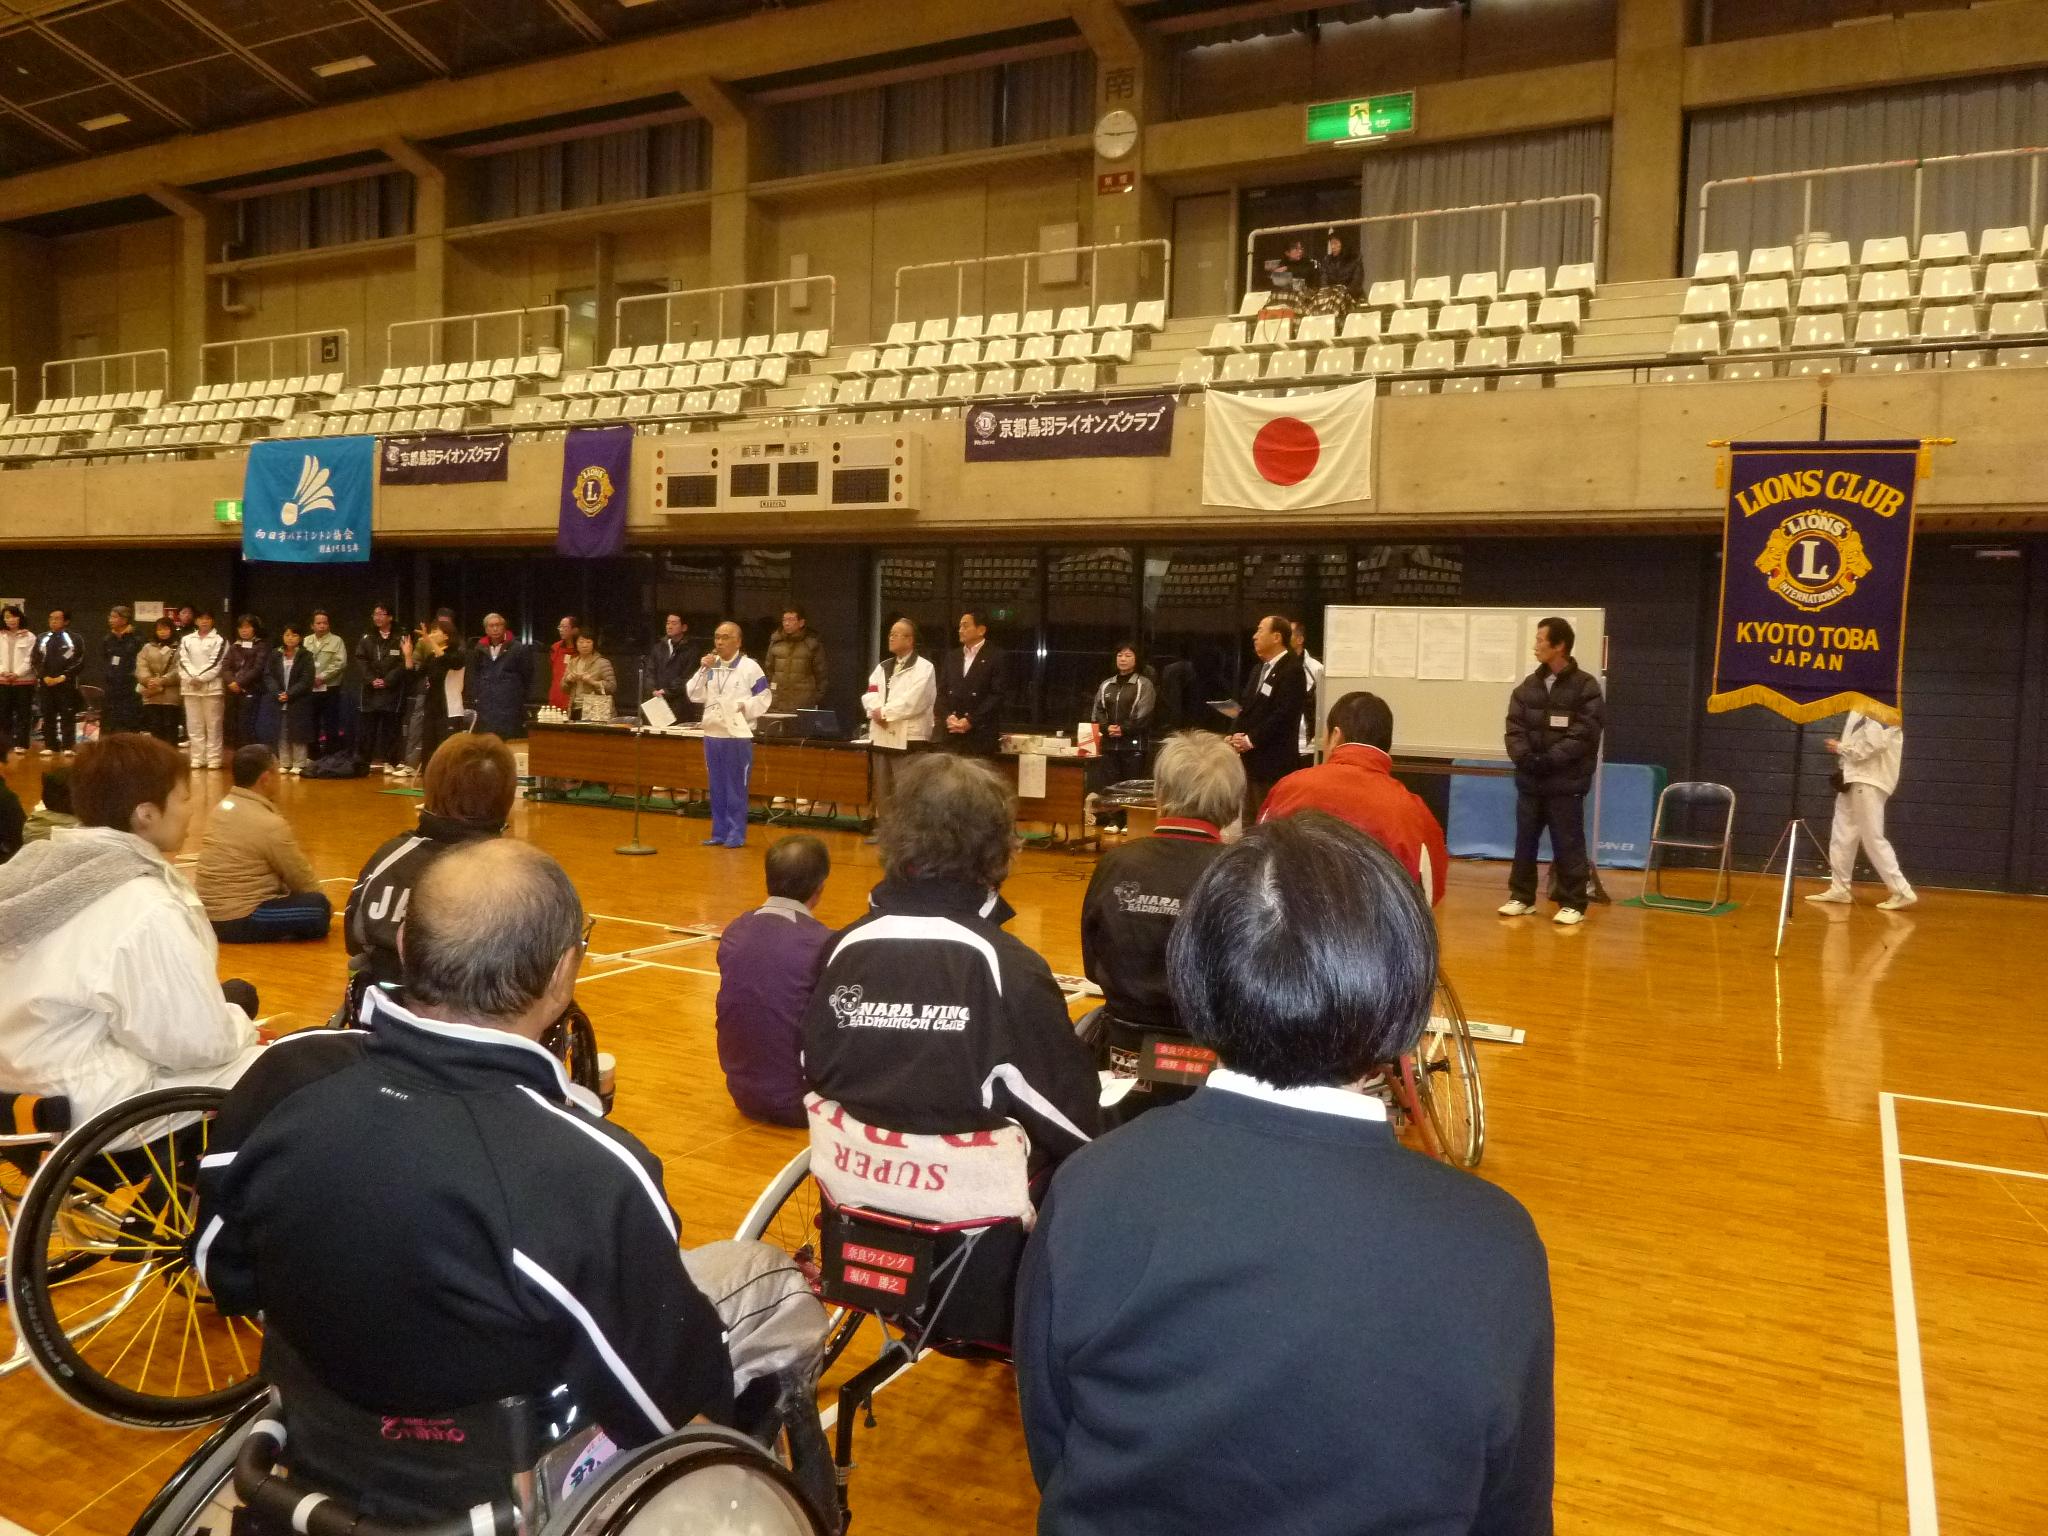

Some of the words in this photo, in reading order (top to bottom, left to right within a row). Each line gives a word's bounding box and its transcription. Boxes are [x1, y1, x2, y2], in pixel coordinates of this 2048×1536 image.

[999, 406, 1166, 438] 京都鳥羽ライオンズクラブ
[586, 481, 598, 501] L
[1735, 469, 1824, 517] LIONS
[1825, 471, 1905, 518] CLUB
[1788, 515, 1846, 536] LIONS
[1798, 540, 1829, 580] L
[1780, 580, 1845, 604] INTERNATIONAL
[1736, 621, 1815, 647] KYOTO
[1818, 626, 1880, 651] TOBA
[1769, 648, 1844, 671] JAPAN
[1137, 895, 1180, 908] NARA
[860, 1002, 914, 1017] NARA
[932, 1019, 966, 1031] CLUB
[834, 1142, 948, 1191] SUPER
[848, 1246, 907, 1269] 奈良ウイング
